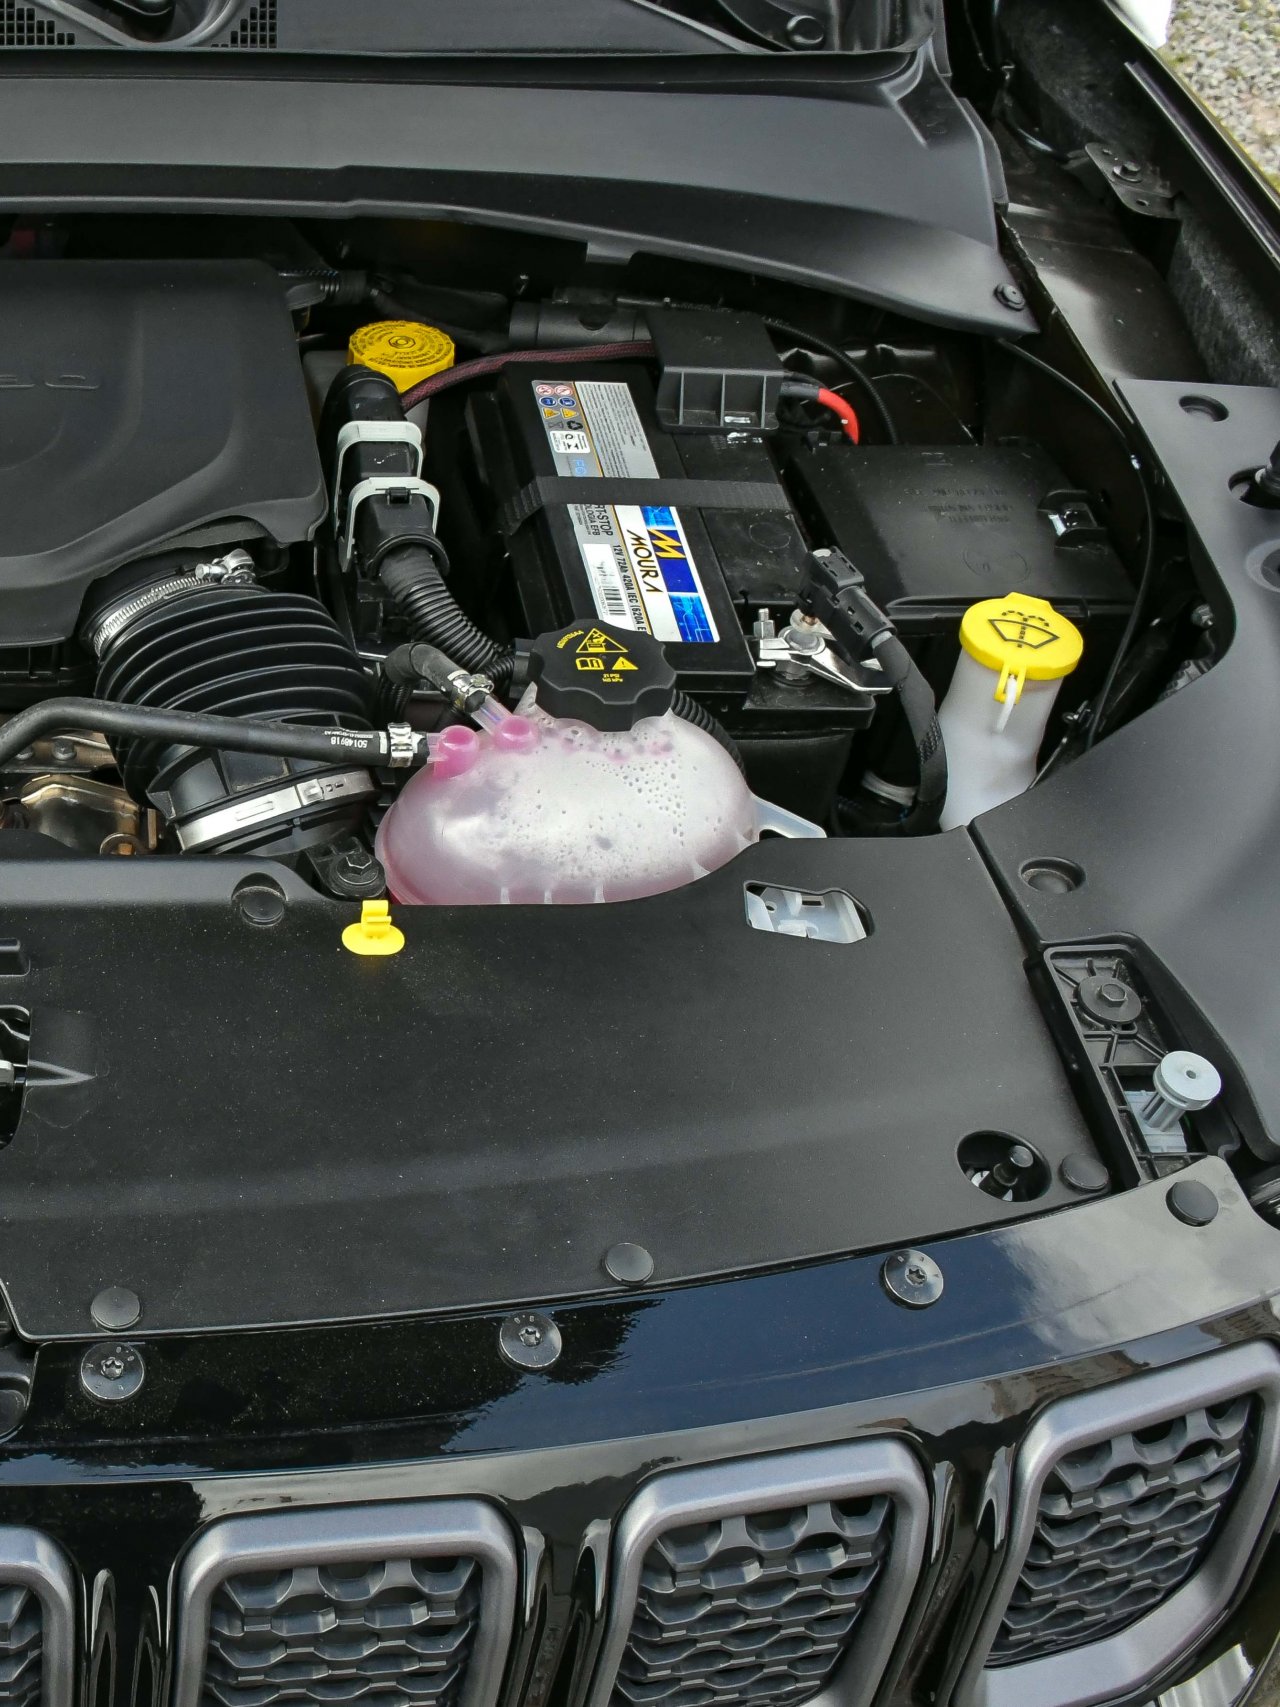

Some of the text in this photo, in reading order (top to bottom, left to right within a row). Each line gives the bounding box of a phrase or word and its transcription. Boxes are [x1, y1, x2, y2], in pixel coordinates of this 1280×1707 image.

[612, 544, 625, 556] 12V
[626, 529, 663, 592] MOURA
[623, 574, 635, 591] 420A
[627, 592, 639, 604] IEC
